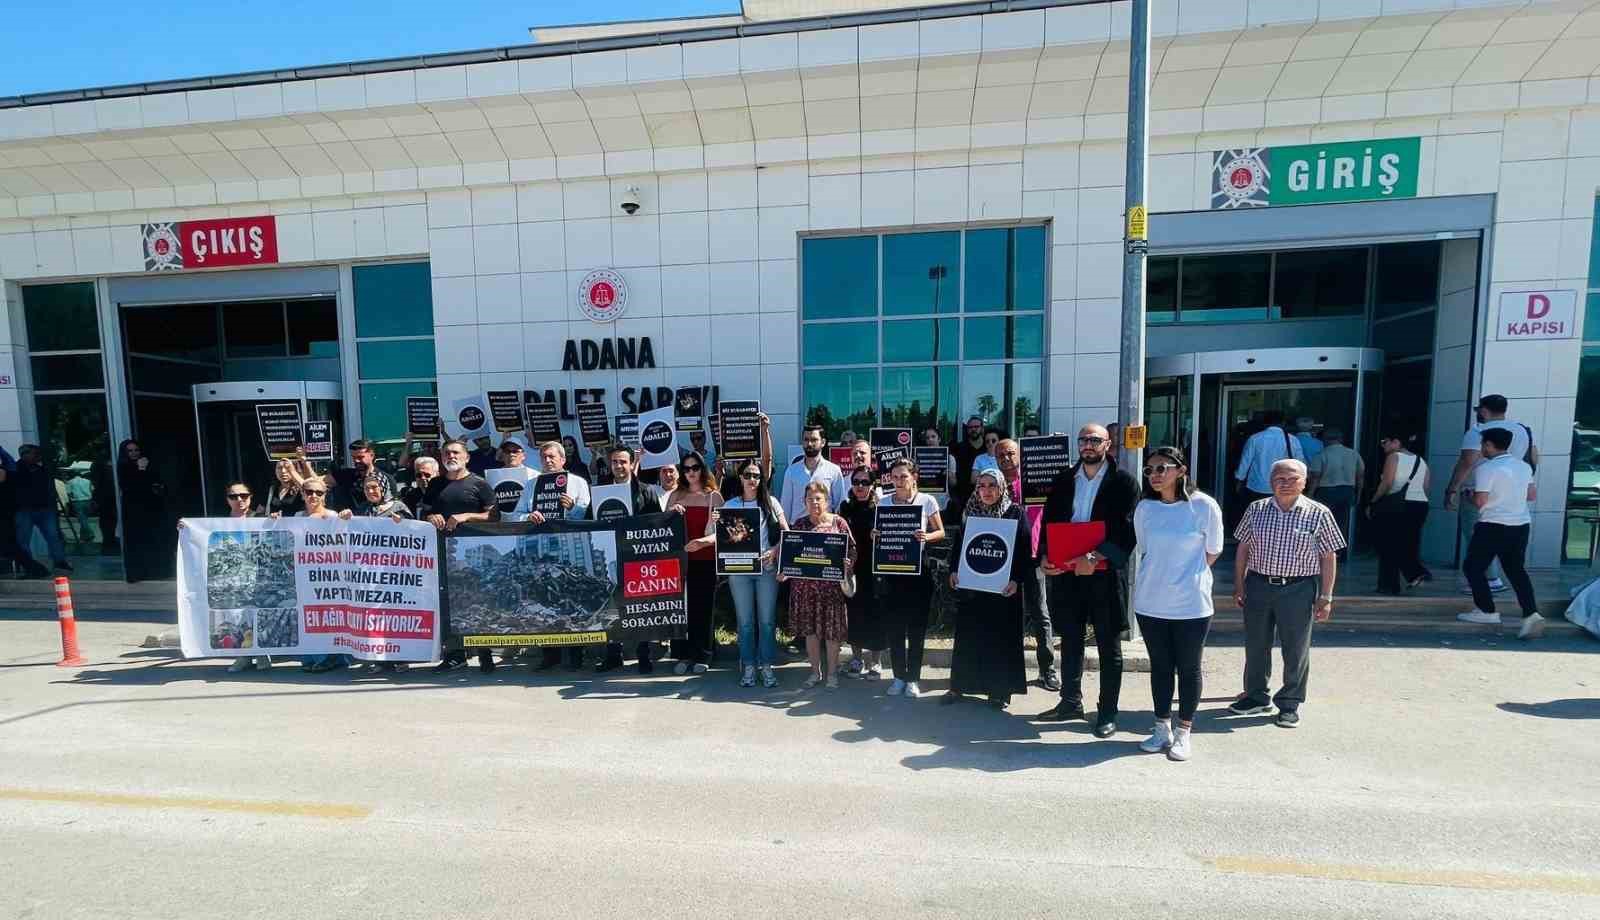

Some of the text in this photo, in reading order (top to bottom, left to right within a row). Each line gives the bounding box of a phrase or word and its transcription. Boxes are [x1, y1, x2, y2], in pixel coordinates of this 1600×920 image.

[1288, 147, 1400, 195] GİRİŞ
[191, 226, 264, 263] ÇIKIŞ
[1527, 294, 1551, 319] D
[562, 337, 655, 370] ADANA
[643, 432, 670, 442] ADALET
[305, 531, 426, 550] İNŞAAT MÜHENDİSİ
[626, 527, 674, 540] BURADA
[632, 542, 670, 554] YATAN
[969, 548, 1005, 558] ADALET
[298, 551, 341, 565] HASAN
[309, 567, 340, 582] BİNA
[640, 565, 658, 577] 96
[627, 578, 678, 593] CANIN
[355, 590, 416, 605] MEZAR...
[626, 601, 683, 614] HESABINI
[305, 611, 320, 625] EN
[322, 608, 344, 626] AĞIR
